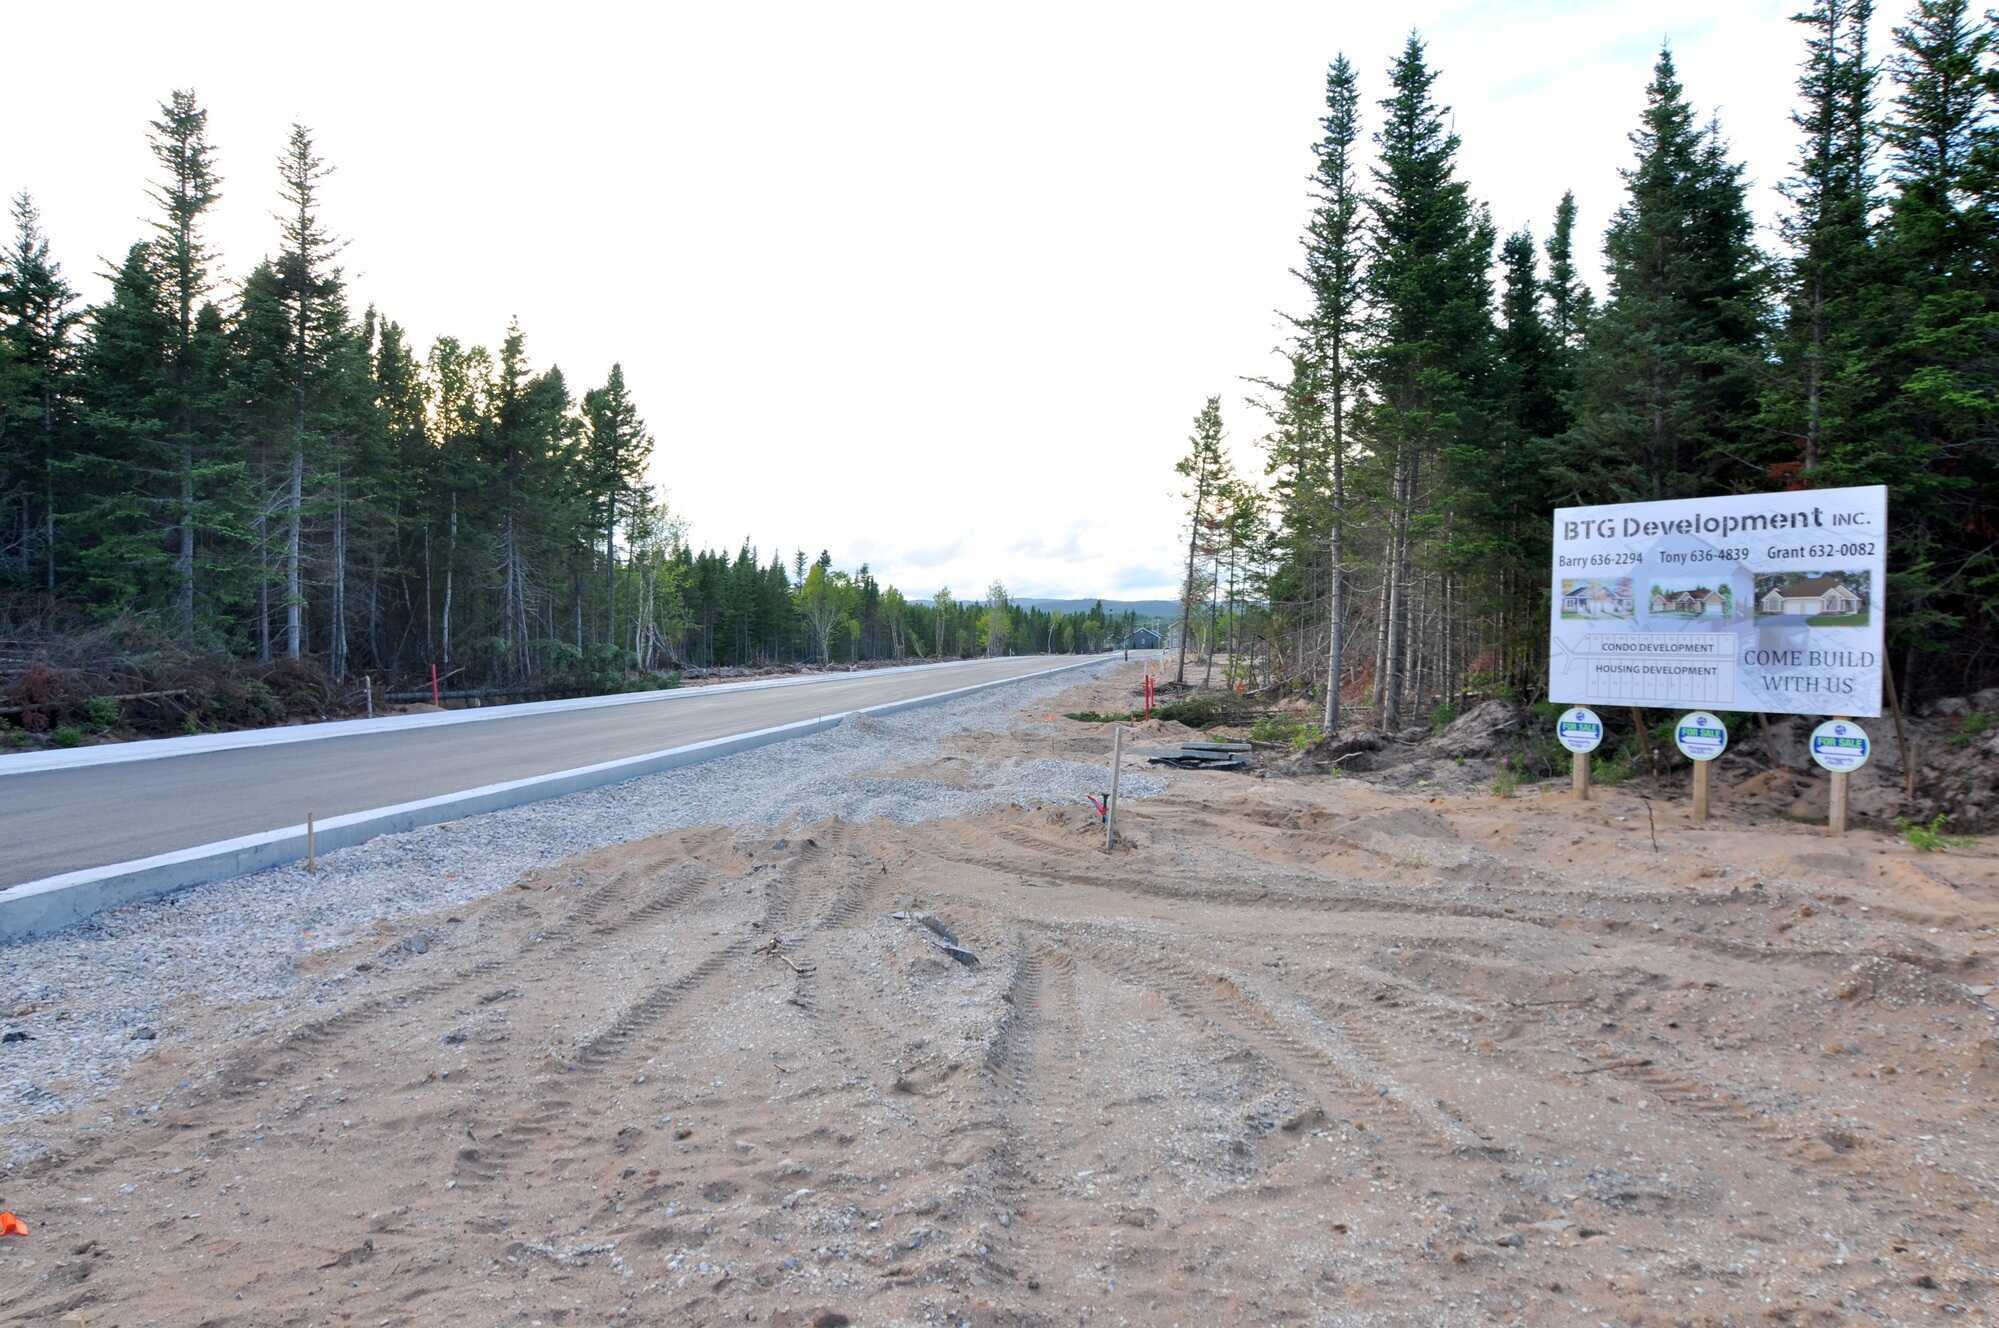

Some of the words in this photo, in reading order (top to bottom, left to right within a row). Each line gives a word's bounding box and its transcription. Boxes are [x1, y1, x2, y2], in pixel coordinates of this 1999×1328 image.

[1563, 518, 1615, 540] BTG
[1623, 507, 1824, 538] Development
[1832, 512, 1871, 527] INC.
[1659, 551, 1687, 566] Tony
[1690, 547, 1749, 562] 636-4839
[1767, 546, 1806, 560] Grant
[1809, 542, 1876, 558] 632-0082
[1559, 555, 1588, 569] Barry
[1590, 552, 1643, 566] 636-2294
[1601, 642, 1638, 652] CONDO
[1639, 643, 1715, 653] DEVELOPMENT
[1744, 650, 1802, 667] COME
[1809, 650, 1875, 668] BUILD
[1595, 664, 1641, 674] HOUSING
[1642, 665, 1718, 675] DEVELOPMENT
[1762, 675, 1818, 693] WITH
[1824, 677, 1854, 694] US
[1682, 726, 1698, 736] FOR
[1701, 728, 1721, 738] SALE
[1816, 736, 1836, 747] FOR
[1839, 737, 1863, 749] SALE
